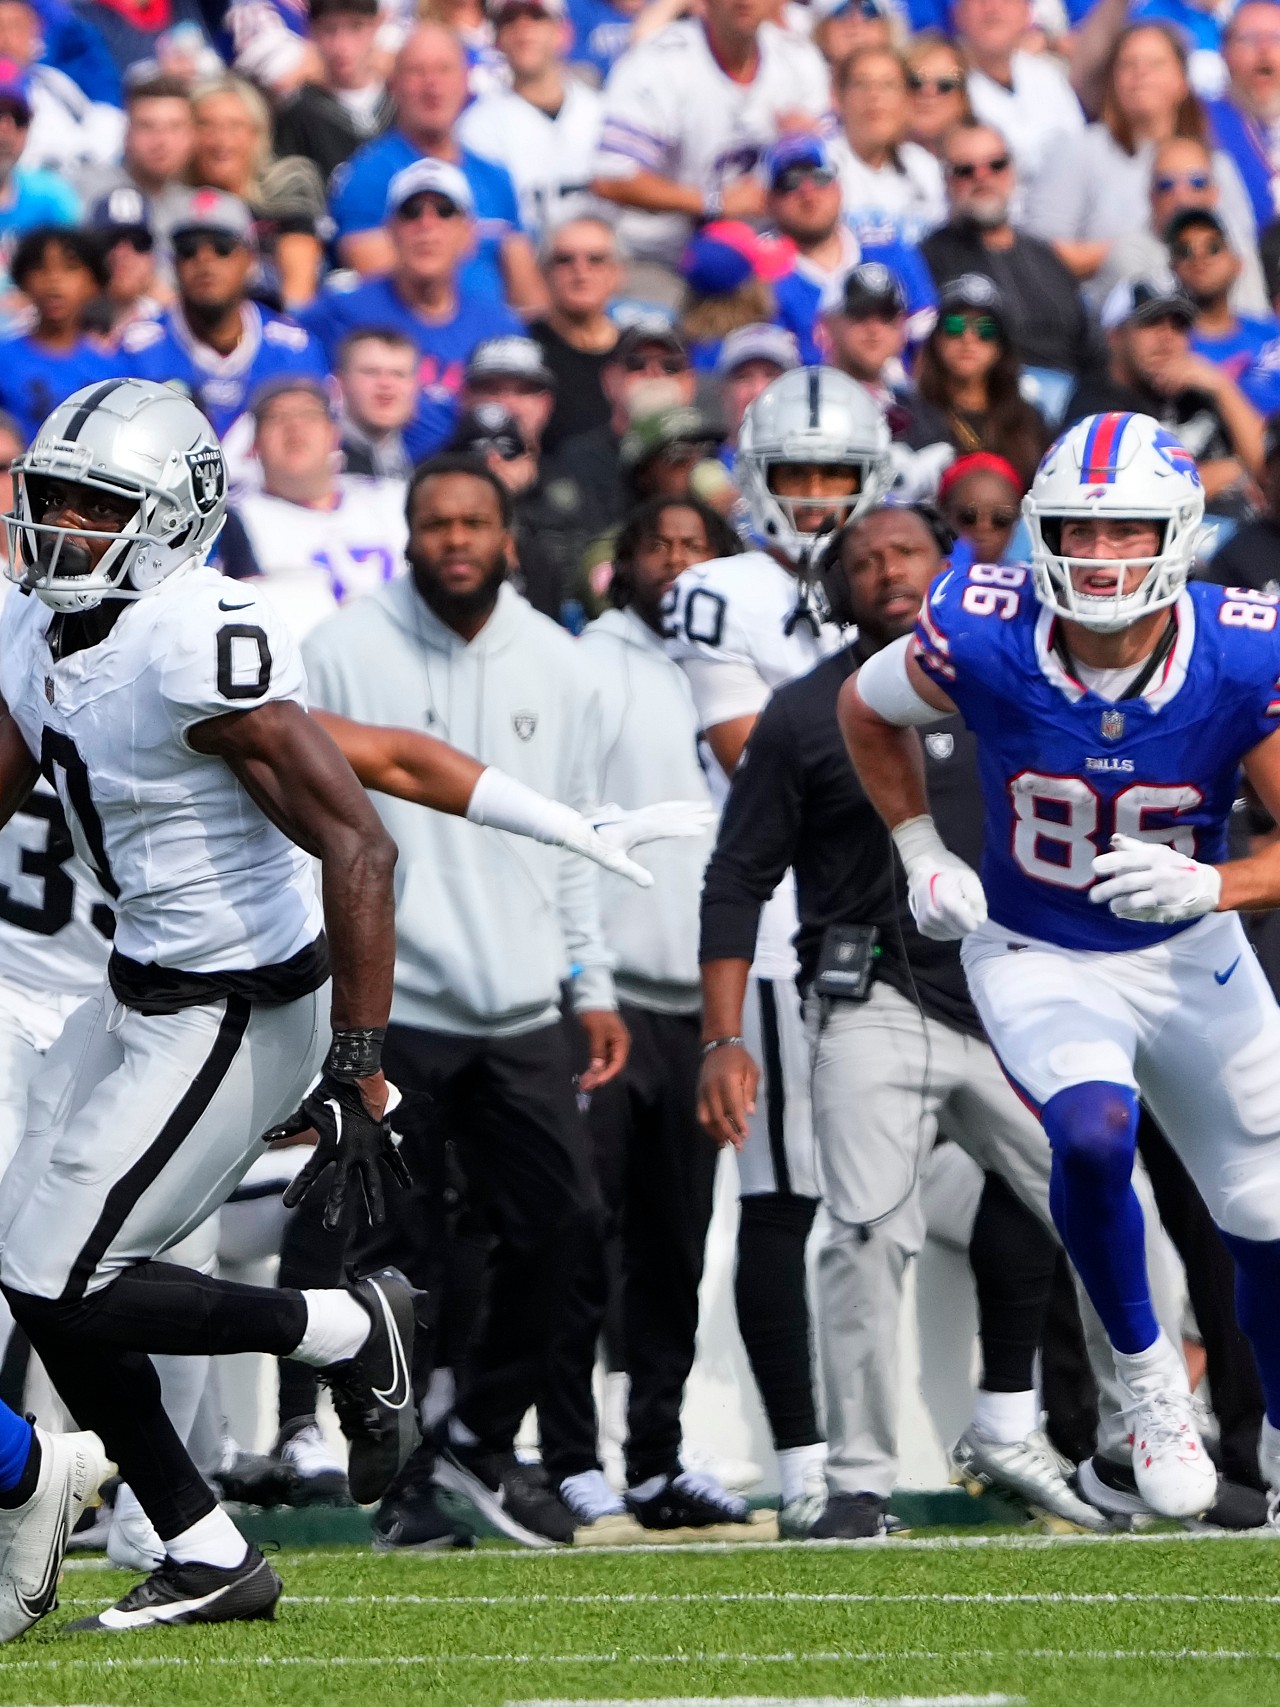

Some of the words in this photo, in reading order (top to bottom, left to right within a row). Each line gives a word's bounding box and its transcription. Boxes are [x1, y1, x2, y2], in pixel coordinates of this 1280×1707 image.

[961, 562, 1026, 620] 86
[214, 622, 274, 700] 0
[1085, 756, 1136, 773] BILLS
